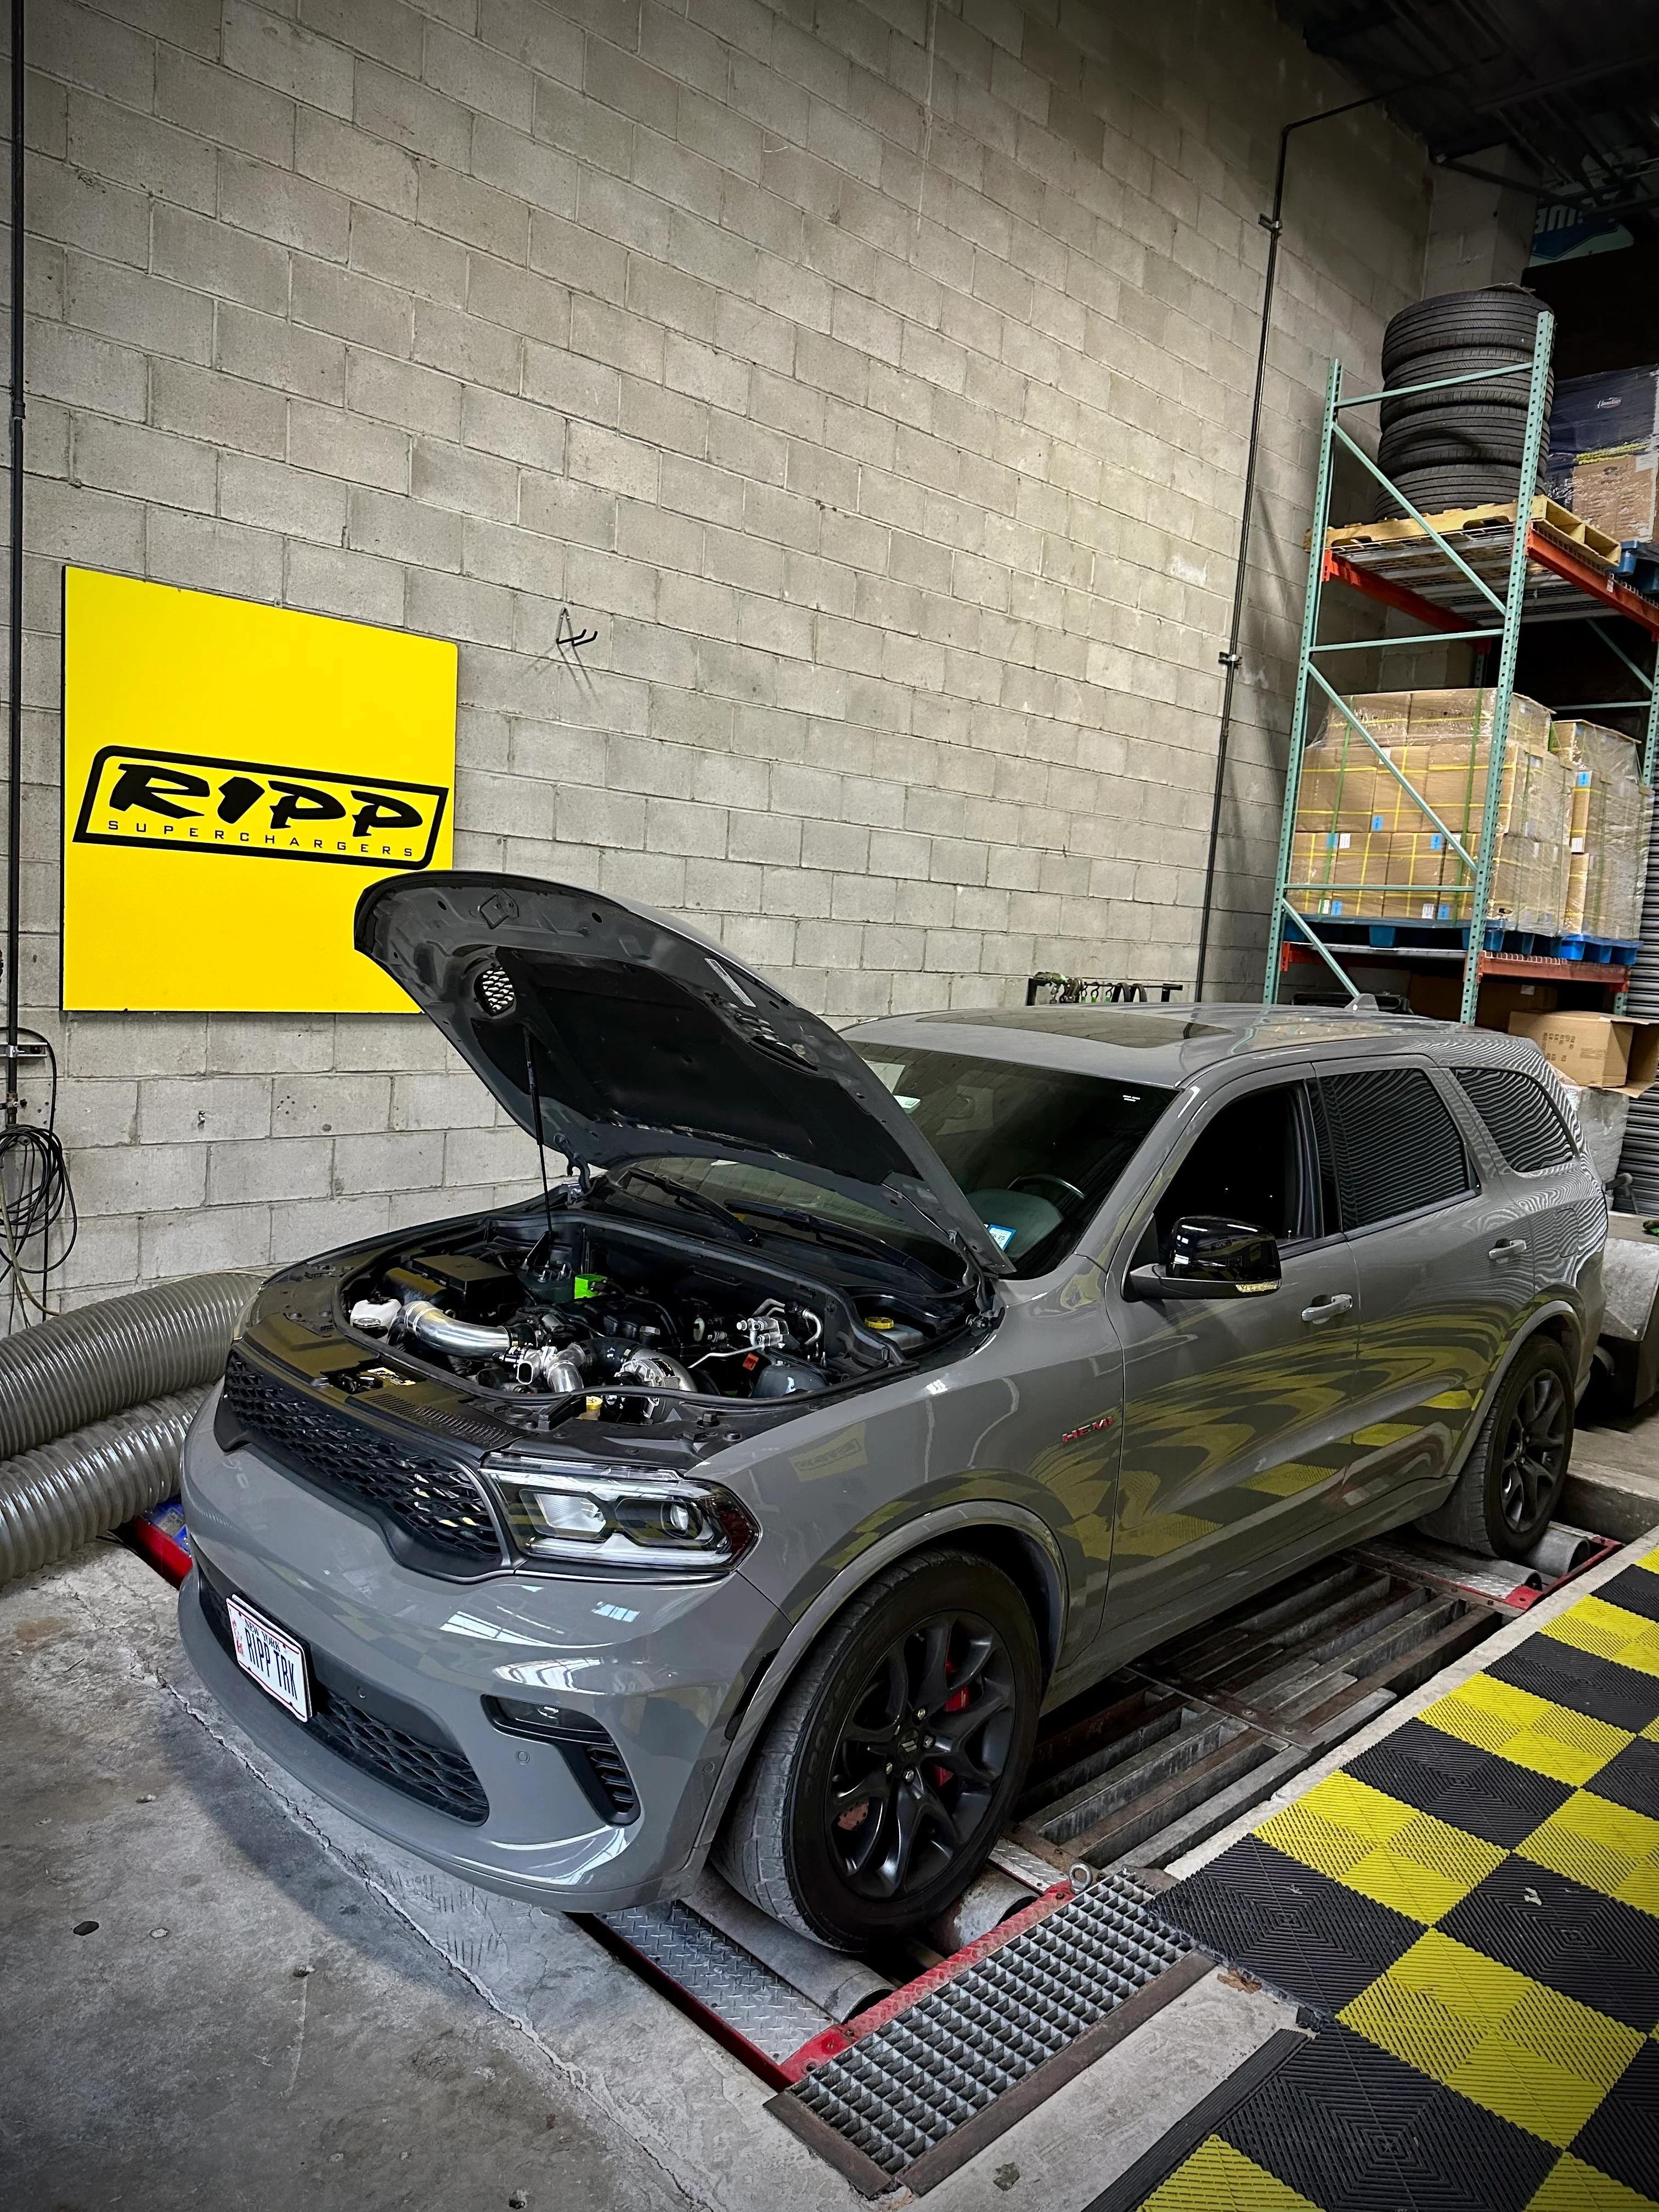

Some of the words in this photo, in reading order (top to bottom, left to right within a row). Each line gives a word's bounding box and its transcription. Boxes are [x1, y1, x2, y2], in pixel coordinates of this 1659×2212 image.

[109, 763, 423, 837] RIPP
[108, 820, 412, 856] SUPERCHARGERS
[1062, 1416, 1114, 1443] HEMI
[245, 1620, 259, 1637] NEW
[262, 1631, 280, 1652] YORK
[245, 1627, 270, 1678] RIPP
[273, 1651, 298, 1700] TRK
